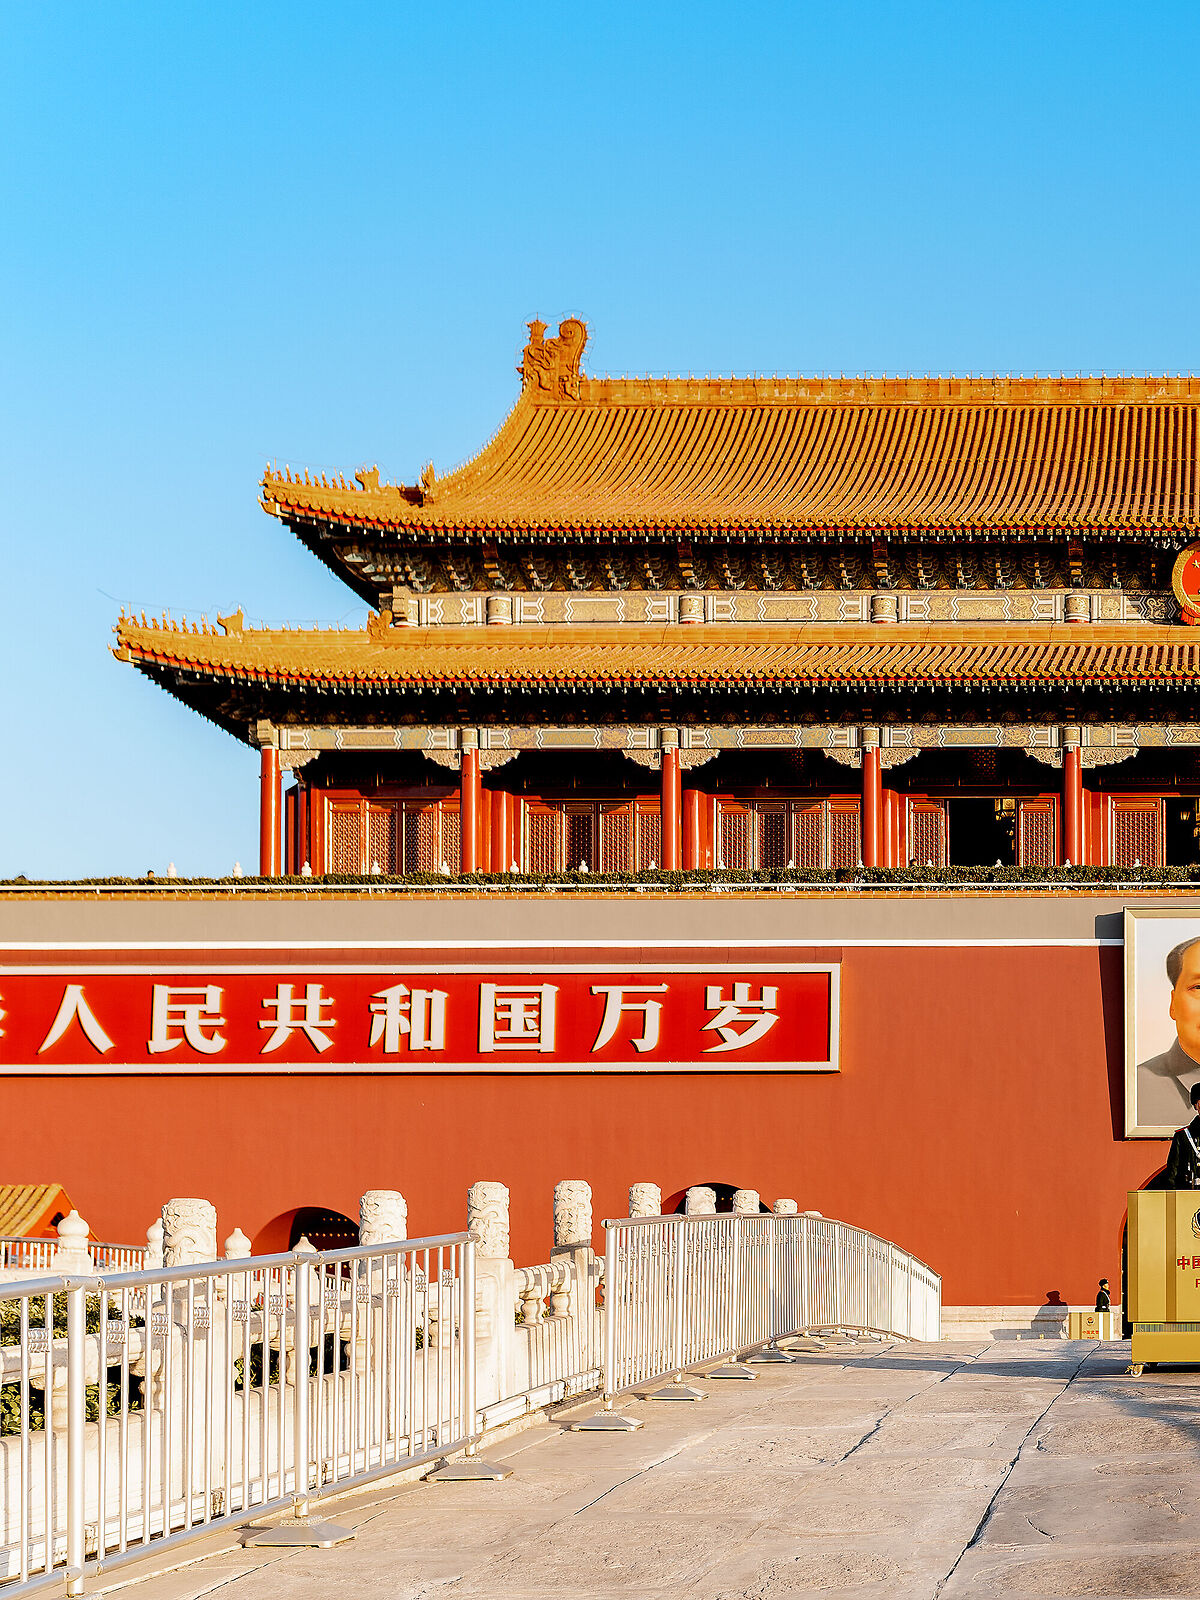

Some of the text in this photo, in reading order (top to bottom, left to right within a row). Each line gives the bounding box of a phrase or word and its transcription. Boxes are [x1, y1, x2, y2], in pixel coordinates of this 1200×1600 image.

[0, 982, 779, 1054] 人民共和国万岁
